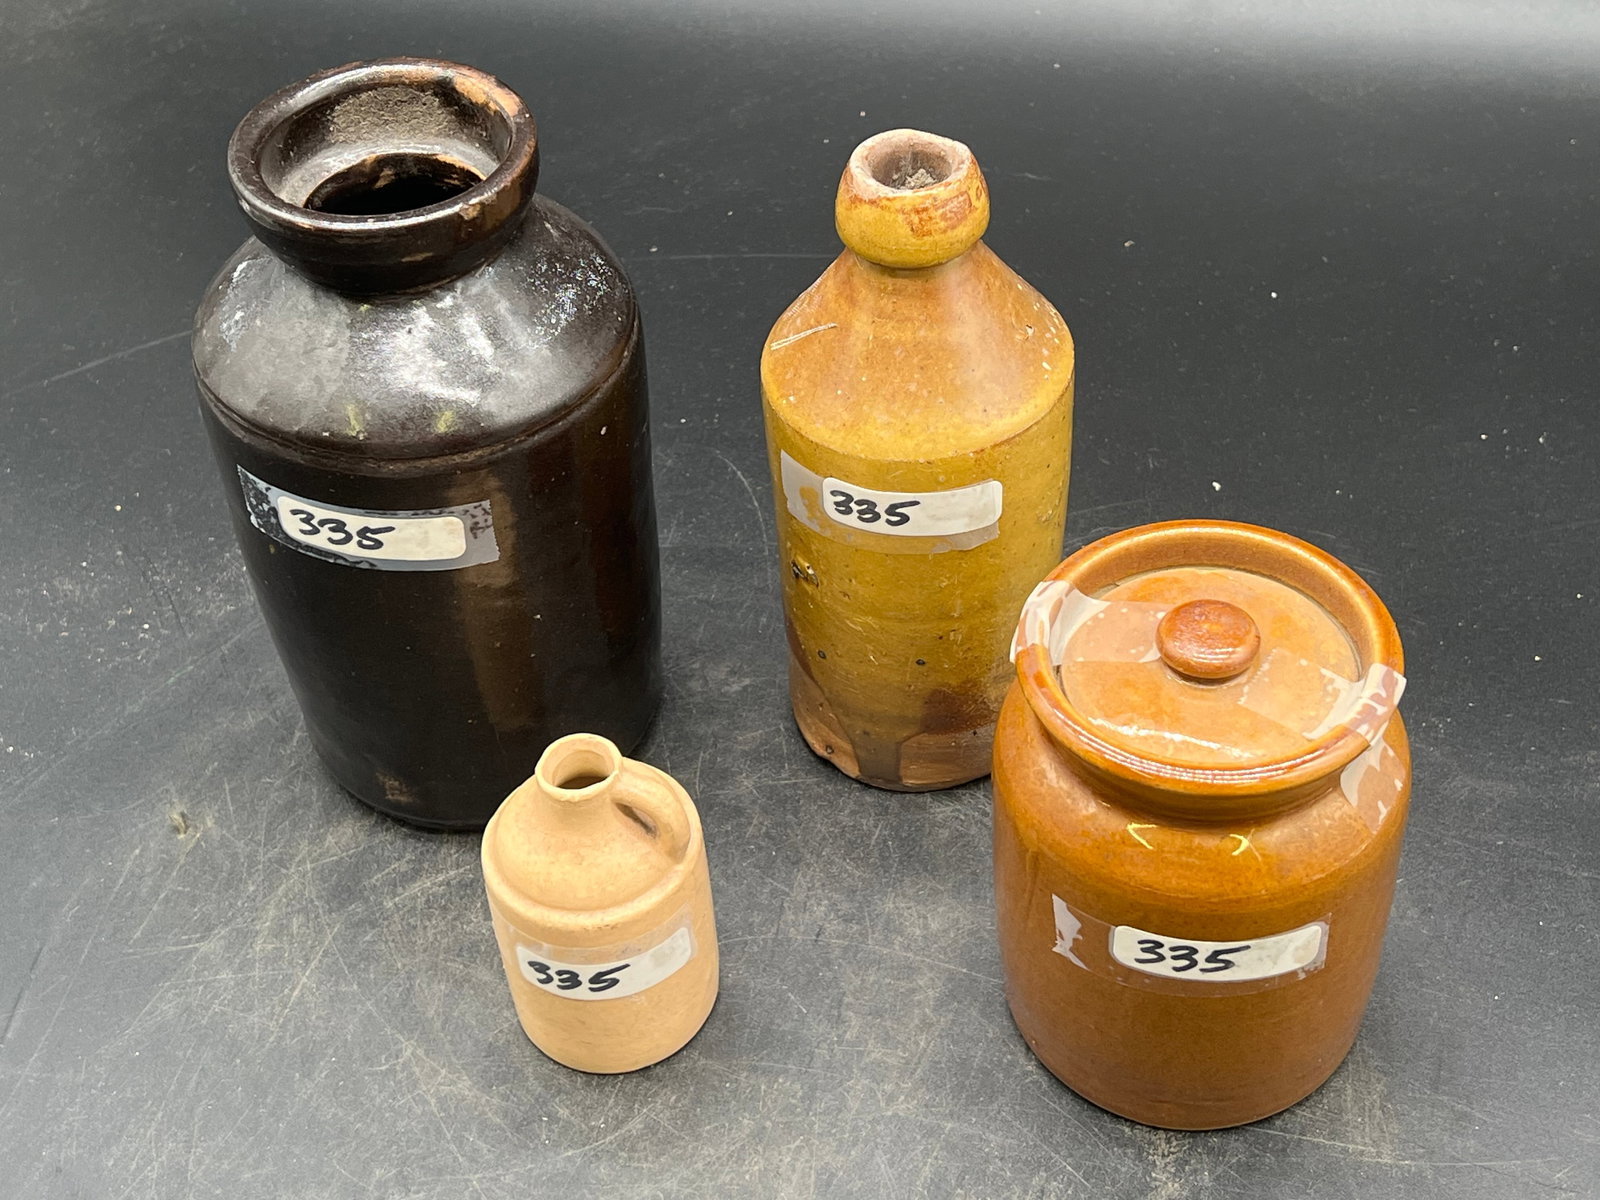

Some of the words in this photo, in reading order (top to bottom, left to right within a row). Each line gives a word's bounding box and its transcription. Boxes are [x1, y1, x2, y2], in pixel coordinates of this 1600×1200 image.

[829, 489, 921, 527] 335
[289, 509, 396, 551] 335
[1134, 939, 1251, 973] 335
[527, 961, 631, 993] 335
